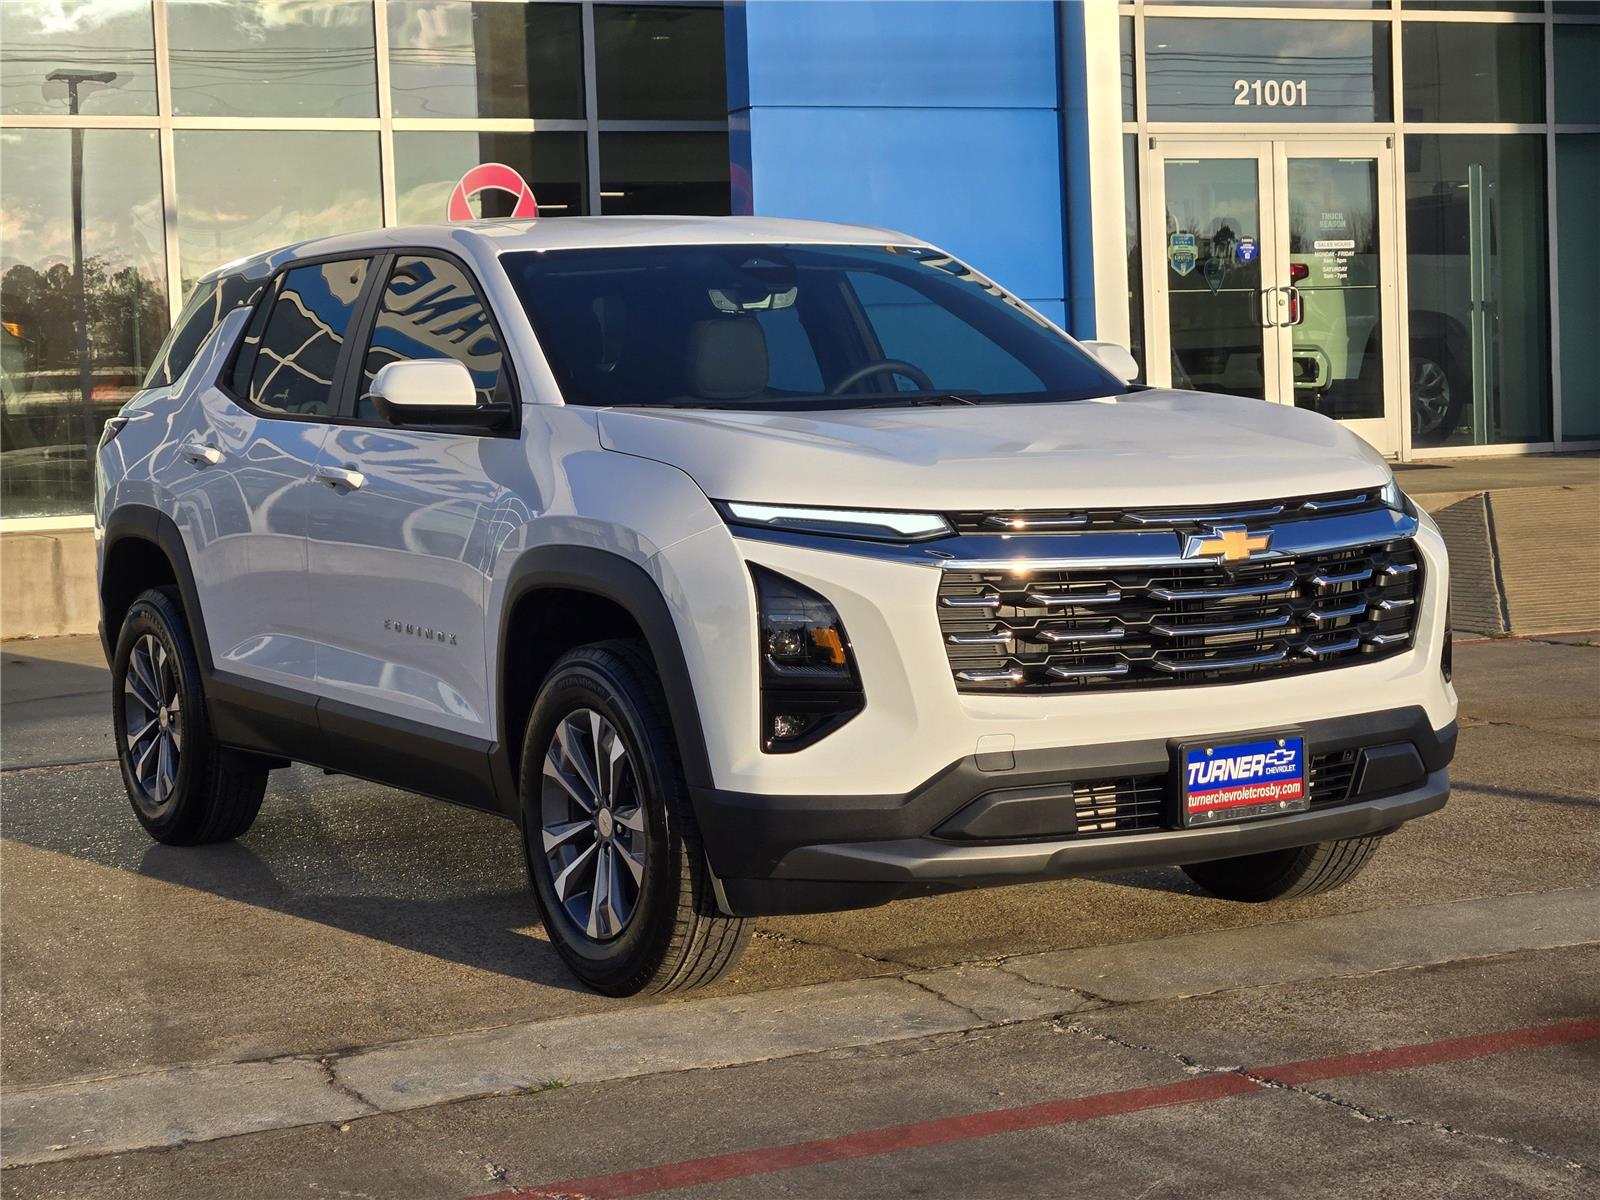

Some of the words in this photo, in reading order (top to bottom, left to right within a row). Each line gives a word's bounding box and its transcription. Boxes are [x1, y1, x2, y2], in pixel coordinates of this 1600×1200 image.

[1234, 79, 1307, 106] 21001
[1319, 220, 1346, 228] SEASON
[1321, 212, 1344, 220] TRUCK
[384, 619, 457, 646] EQUINOX
[1187, 754, 1266, 785] TURNER
[1265, 764, 1297, 775] CHEVROLET
[1188, 782, 1301, 807] turnerchevroletcrosby.com
